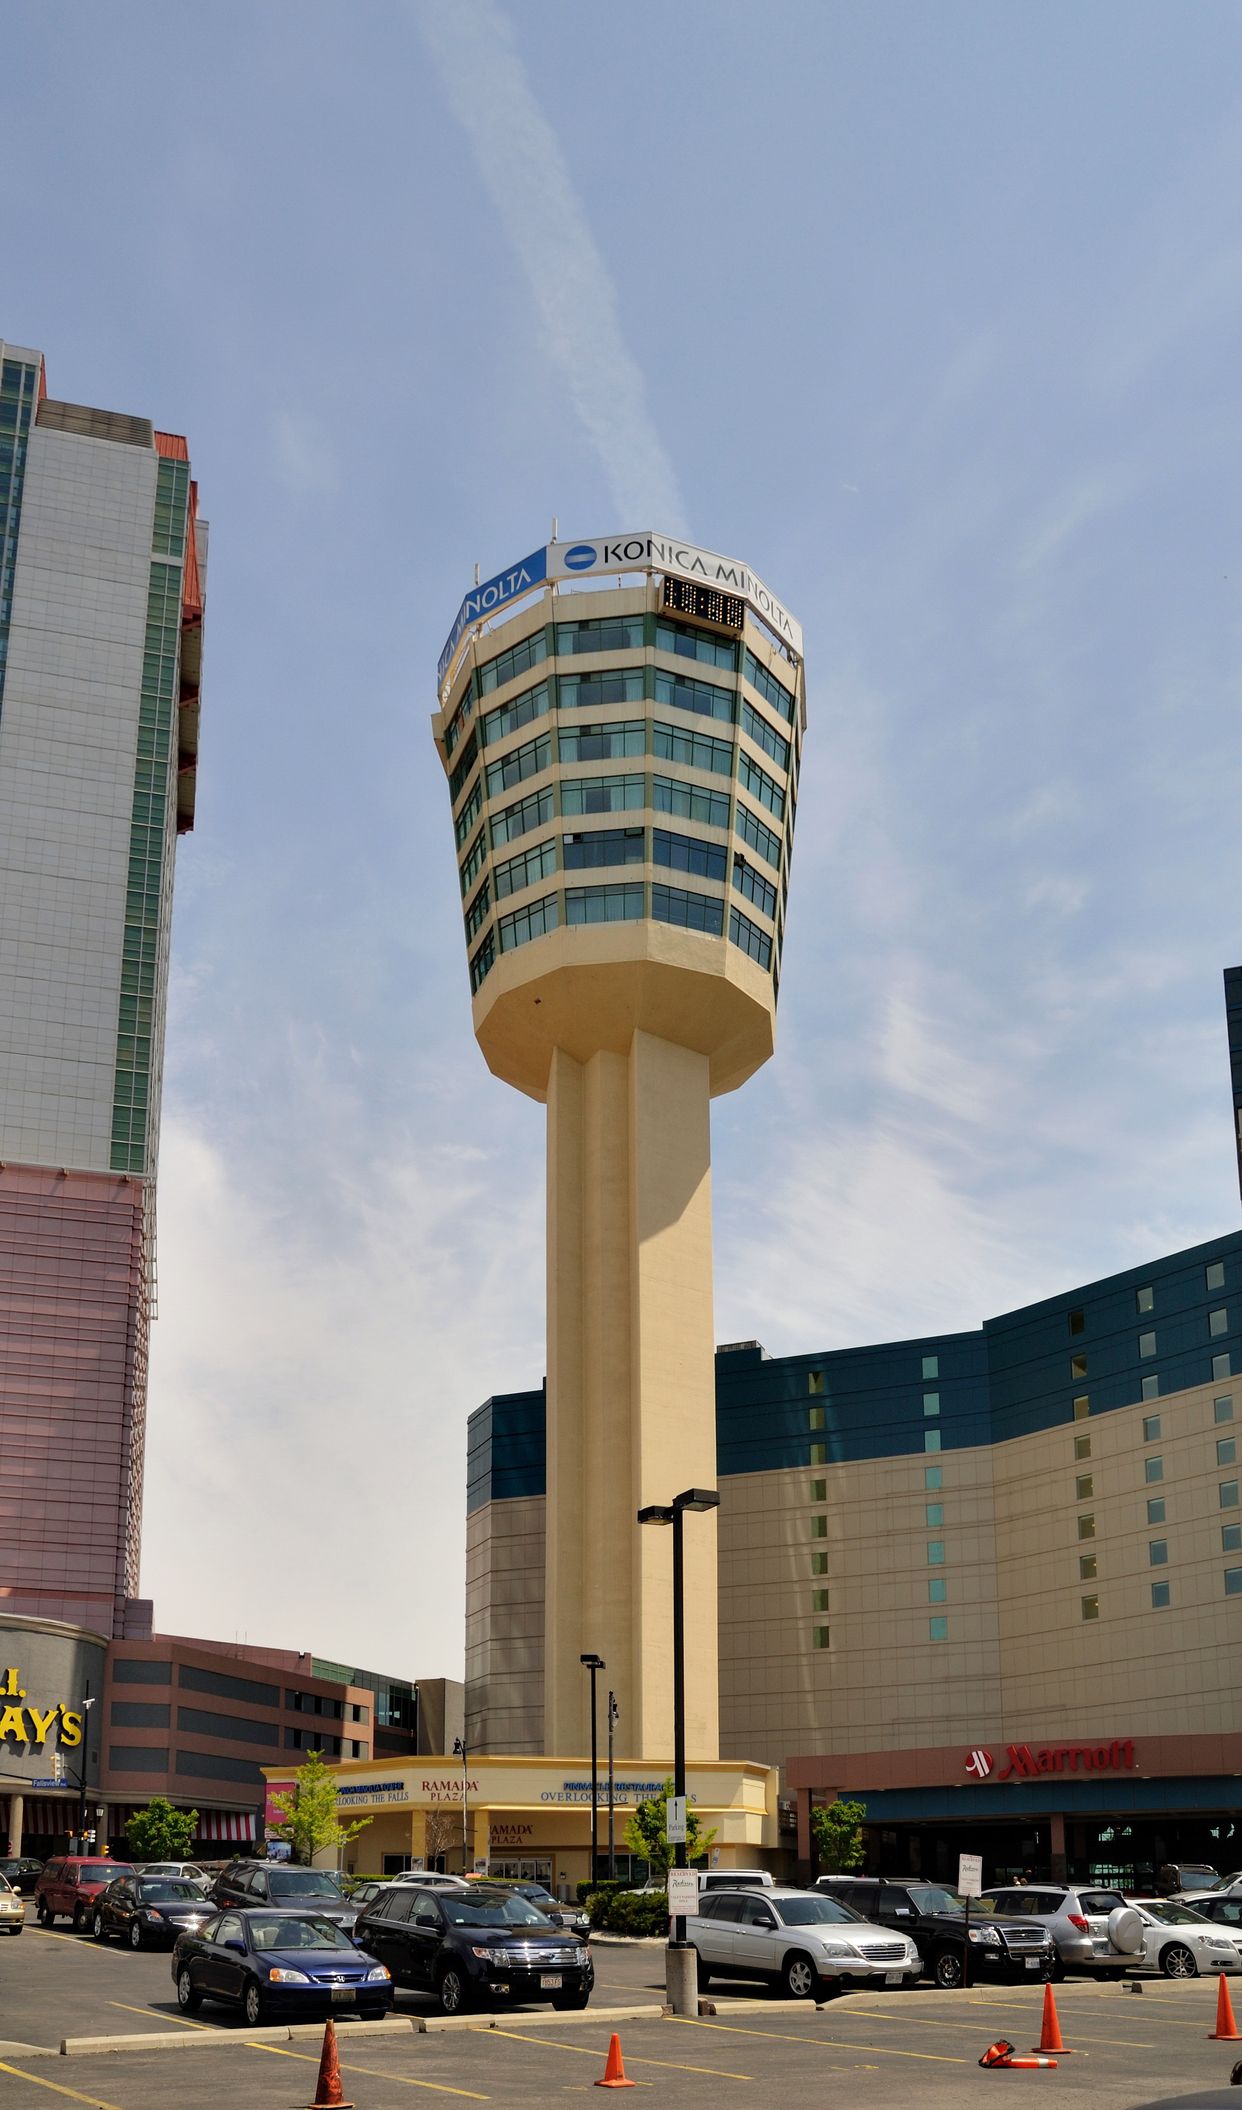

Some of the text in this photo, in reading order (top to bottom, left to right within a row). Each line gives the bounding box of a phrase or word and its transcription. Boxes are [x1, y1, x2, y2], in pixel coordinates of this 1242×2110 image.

[604, 540, 794, 640] KONICA MINOLTA
[998, 1740, 1134, 1780] Marriott
[371, 1794, 385, 1803] THE
[388, 1791, 409, 1802] FALLS
[422, 1781, 479, 1791] RAMADA
